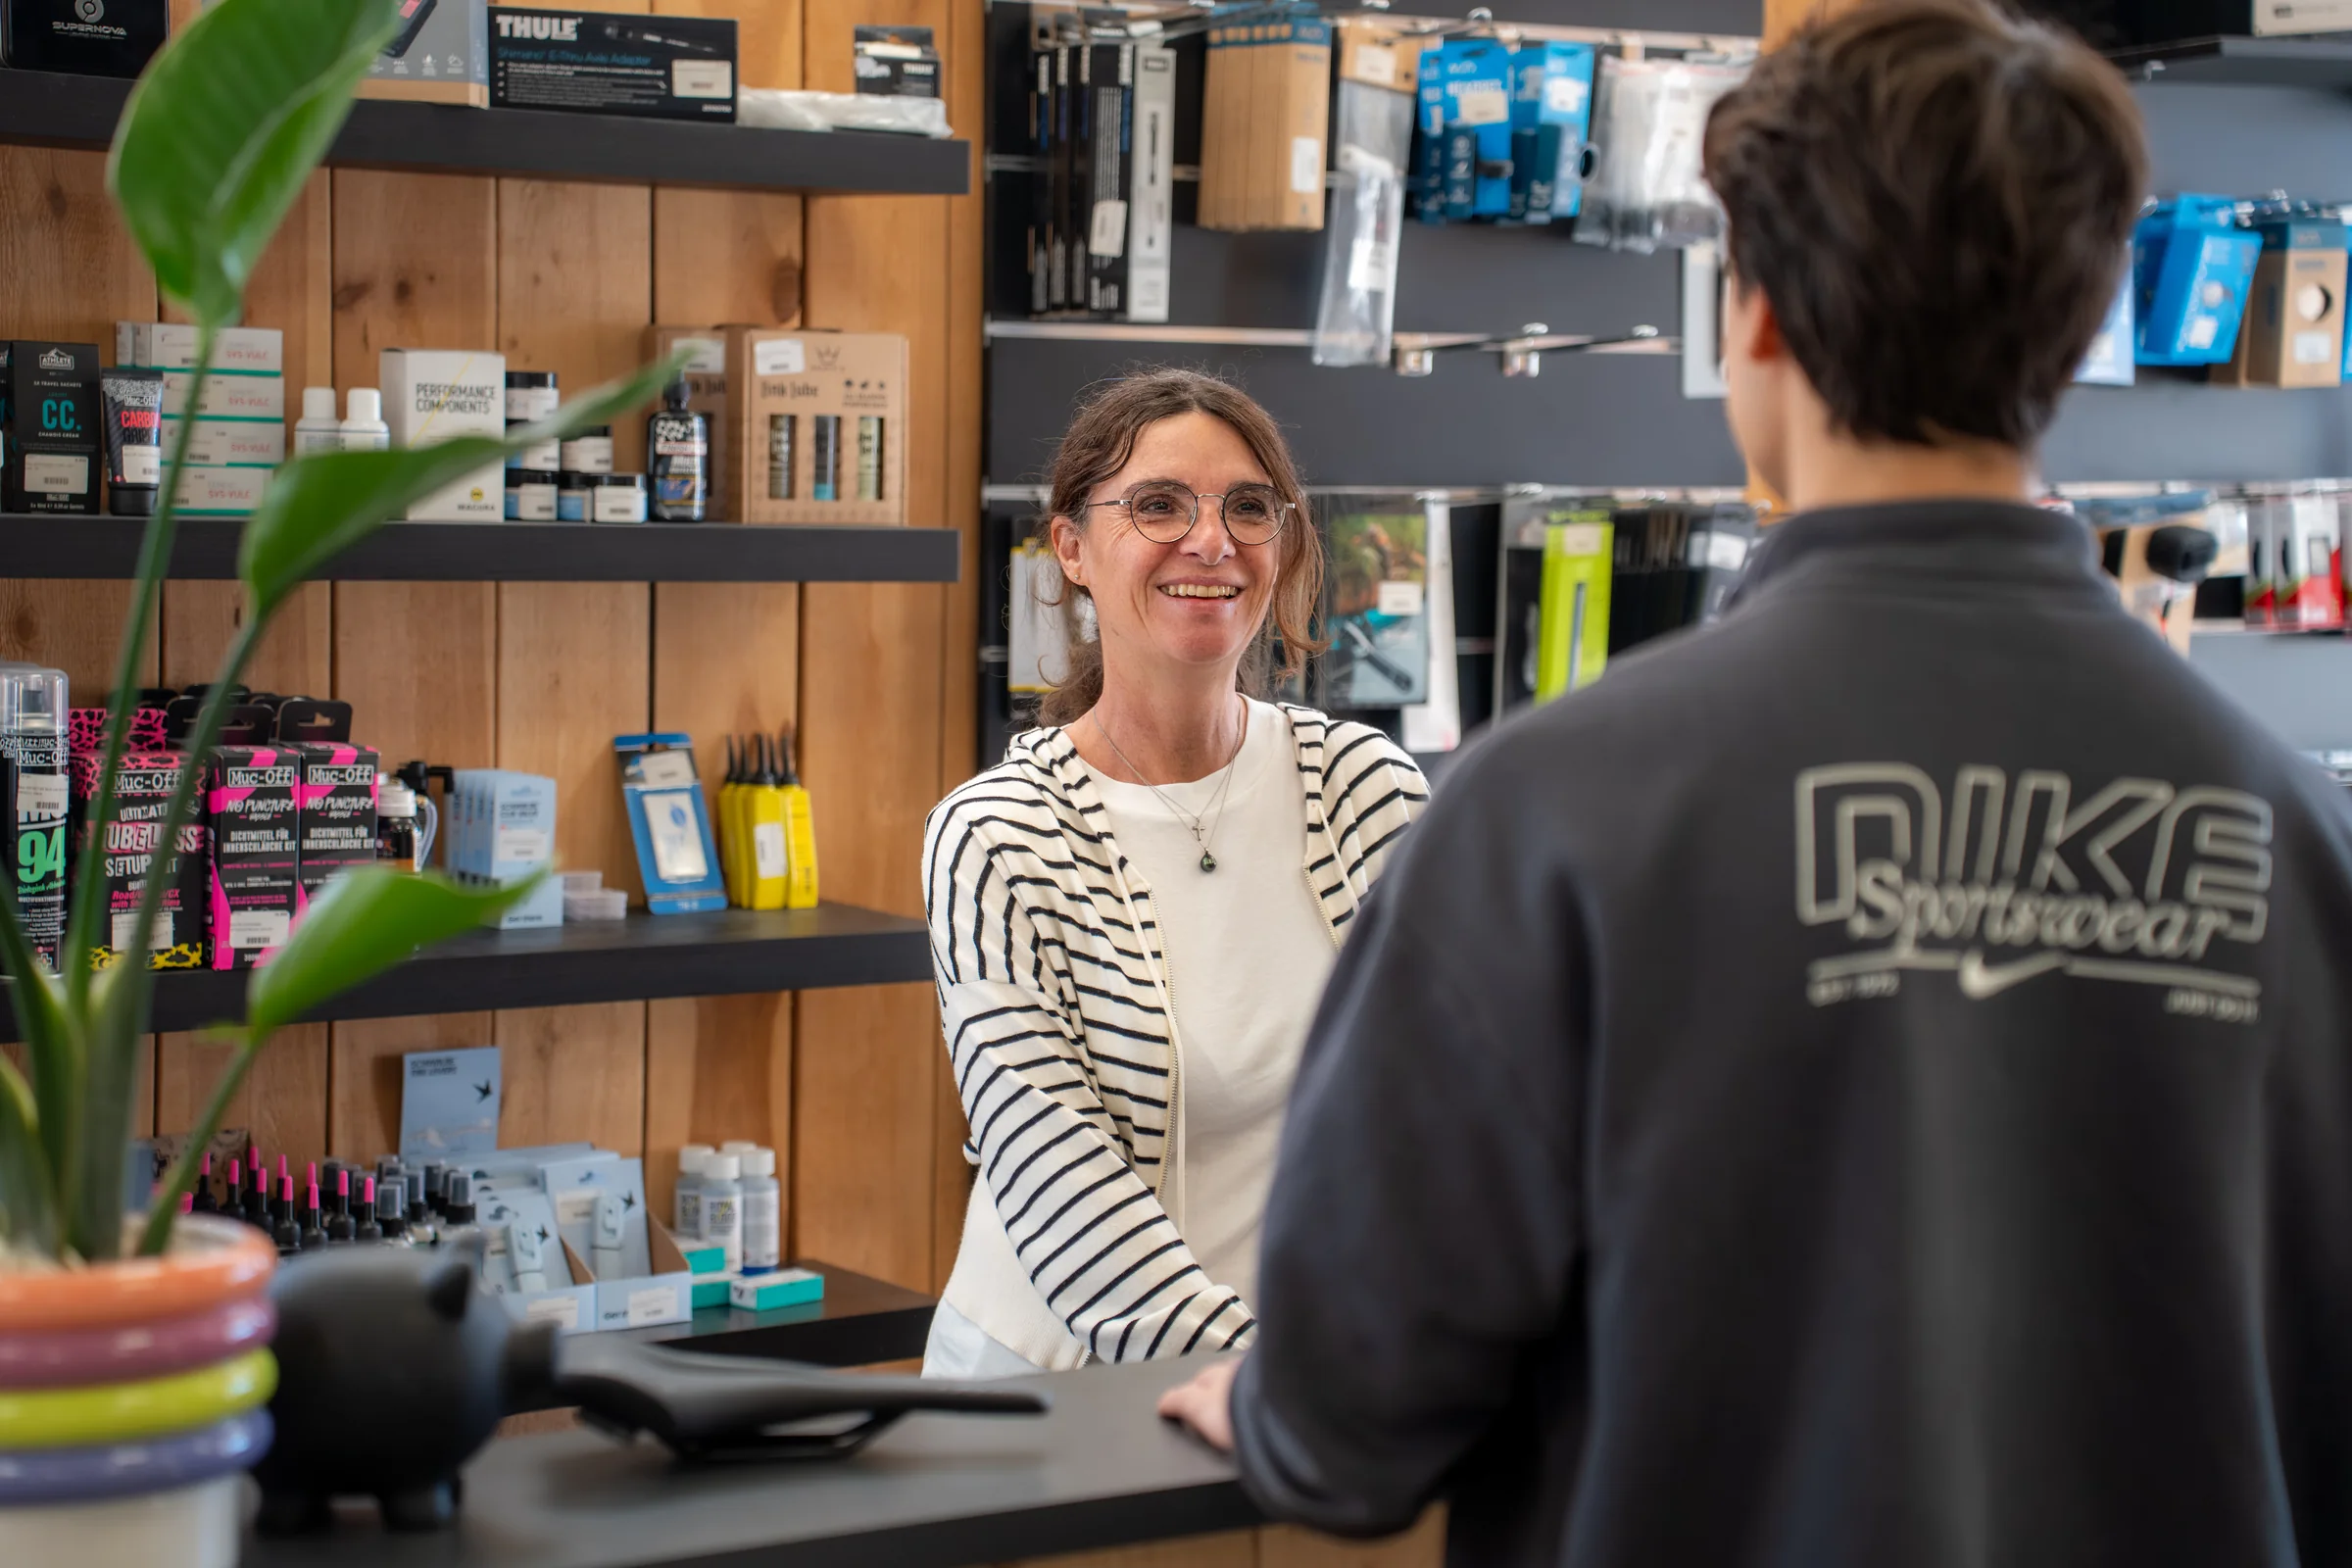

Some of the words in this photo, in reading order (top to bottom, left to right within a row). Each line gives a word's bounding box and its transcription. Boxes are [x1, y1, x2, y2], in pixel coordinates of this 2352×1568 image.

[52, 22, 126, 35] SUPERNOVA
[496, 14, 578, 41] THULE
[416, 382, 496, 400] PERFORMANCE
[416, 399, 490, 415] COMPONENTS
[20, 751, 68, 764] Muc-Off
[114, 771, 181, 791] Muc-Off
[231, 767, 291, 785] Muc-Off
[312, 766, 371, 783] Muc-Off
[225, 799, 245, 812] NO
[245, 798, 296, 812] PUNCTURE
[306, 798, 324, 810] NO
[324, 796, 375, 810] PUNCTURE
[105, 823, 198, 852] UBELSS
[230, 829, 274, 842] DICHTMITTEL
[275, 827, 289, 841] FÜR
[310, 827, 354, 840] DICHTMITTEL
[355, 825, 368, 838] FÜR
[285, 840, 297, 853] KIT
[364, 837, 374, 850] KIT
[1795, 760, 2274, 942] NIKE
[17, 824, 66, 883] 94
[105, 855, 153, 877] SETUP
[1846, 858, 2233, 959] Sportswear
